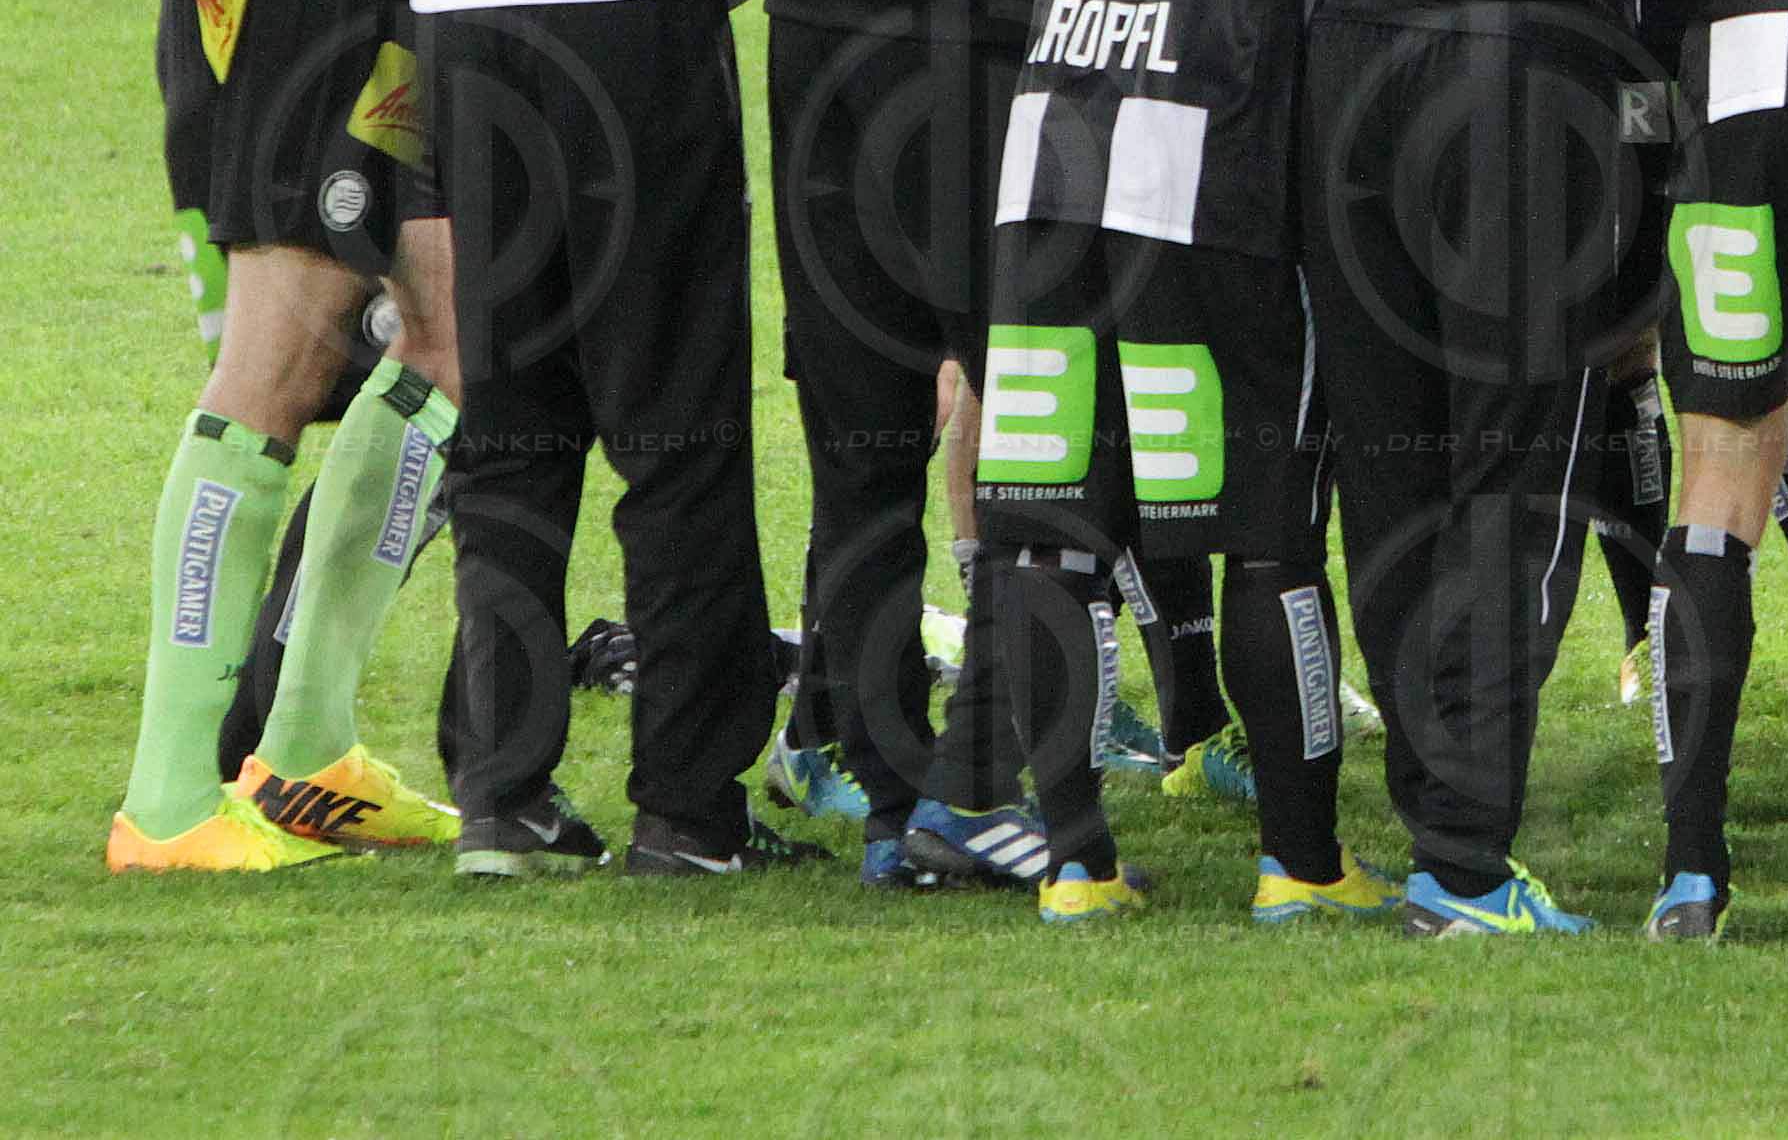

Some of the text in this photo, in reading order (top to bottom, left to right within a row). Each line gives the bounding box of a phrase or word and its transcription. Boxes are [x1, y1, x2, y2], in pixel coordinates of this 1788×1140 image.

[996, 485, 1086, 501] STEIERMARK
[175, 489, 230, 639] PUNTIGAMER
[1295, 596, 1335, 751] PUNTIGAMER
[252, 773, 384, 834] NIKE
